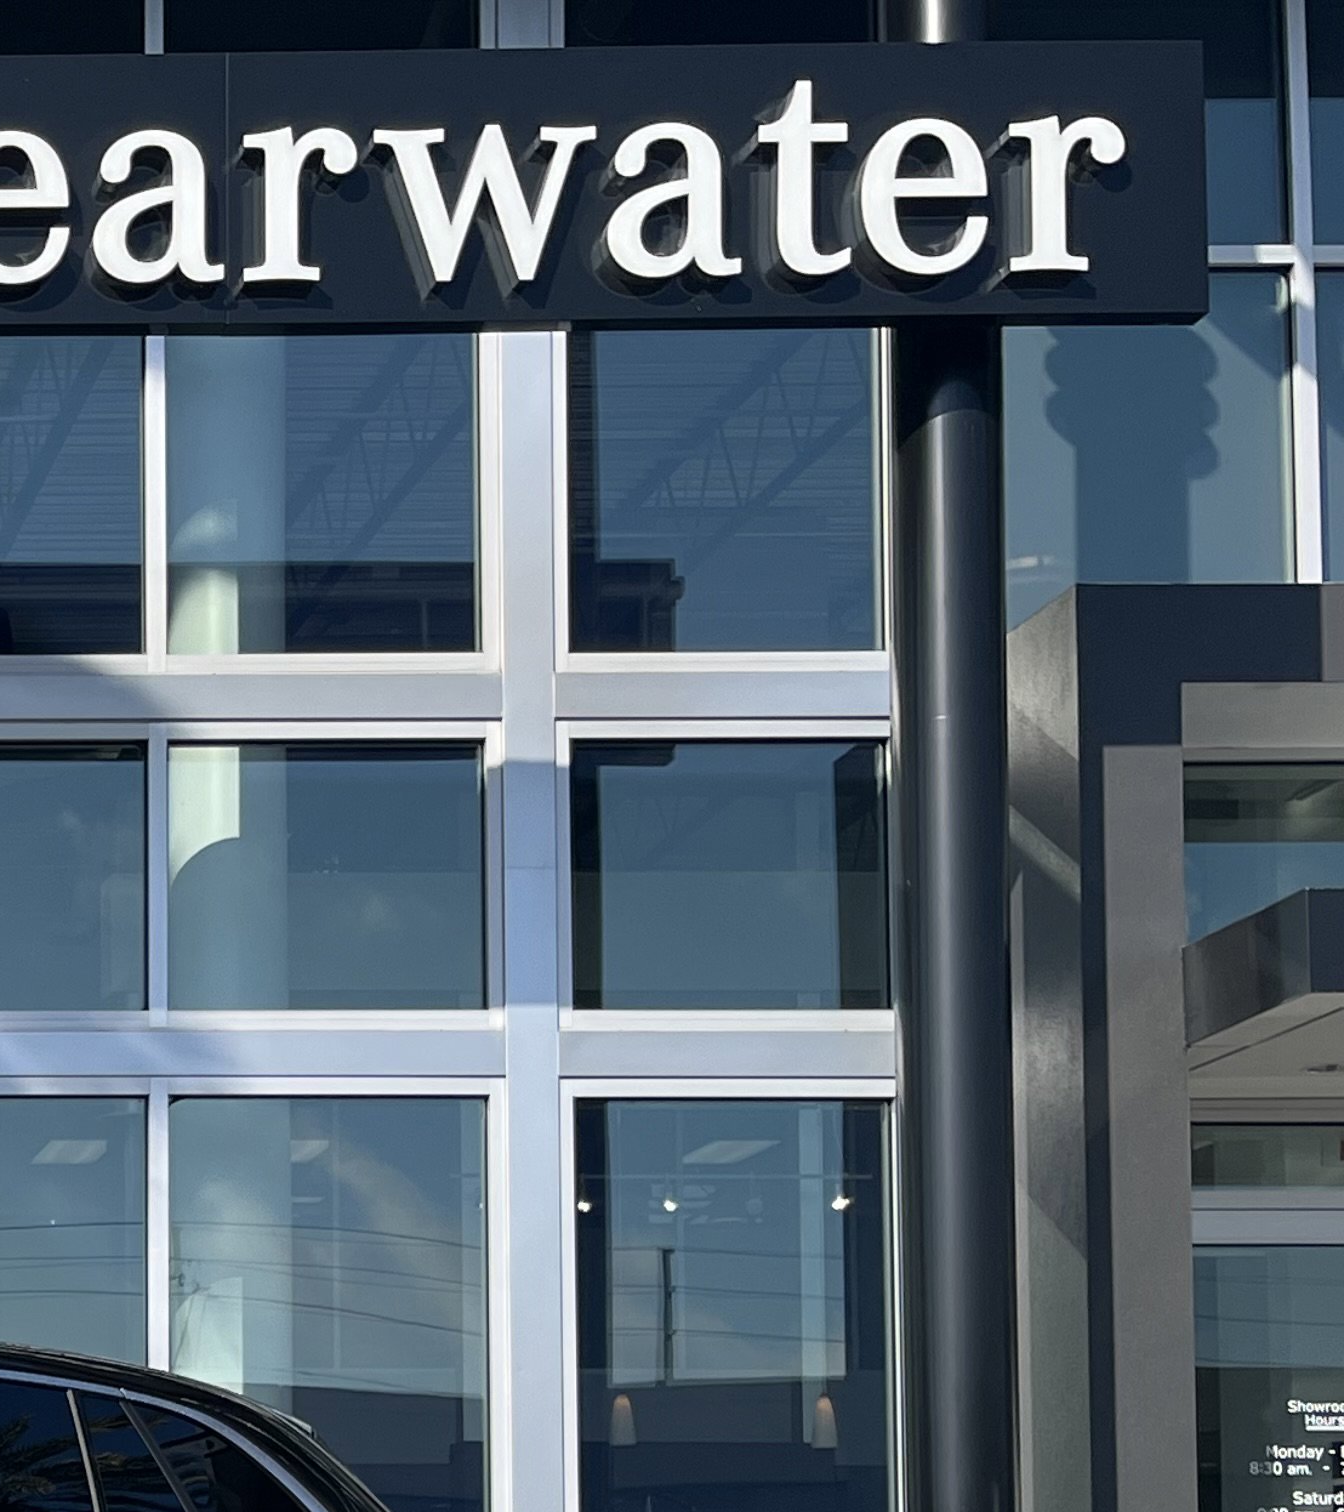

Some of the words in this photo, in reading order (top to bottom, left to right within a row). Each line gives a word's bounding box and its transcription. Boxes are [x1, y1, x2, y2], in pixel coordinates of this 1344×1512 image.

[1287, 1400, 1344, 1413] Showro
[1266, 1444, 1324, 1461] Monday
[1249, 1461, 1283, 1476] 8:30
[1286, 1464, 1313, 1476] am.
